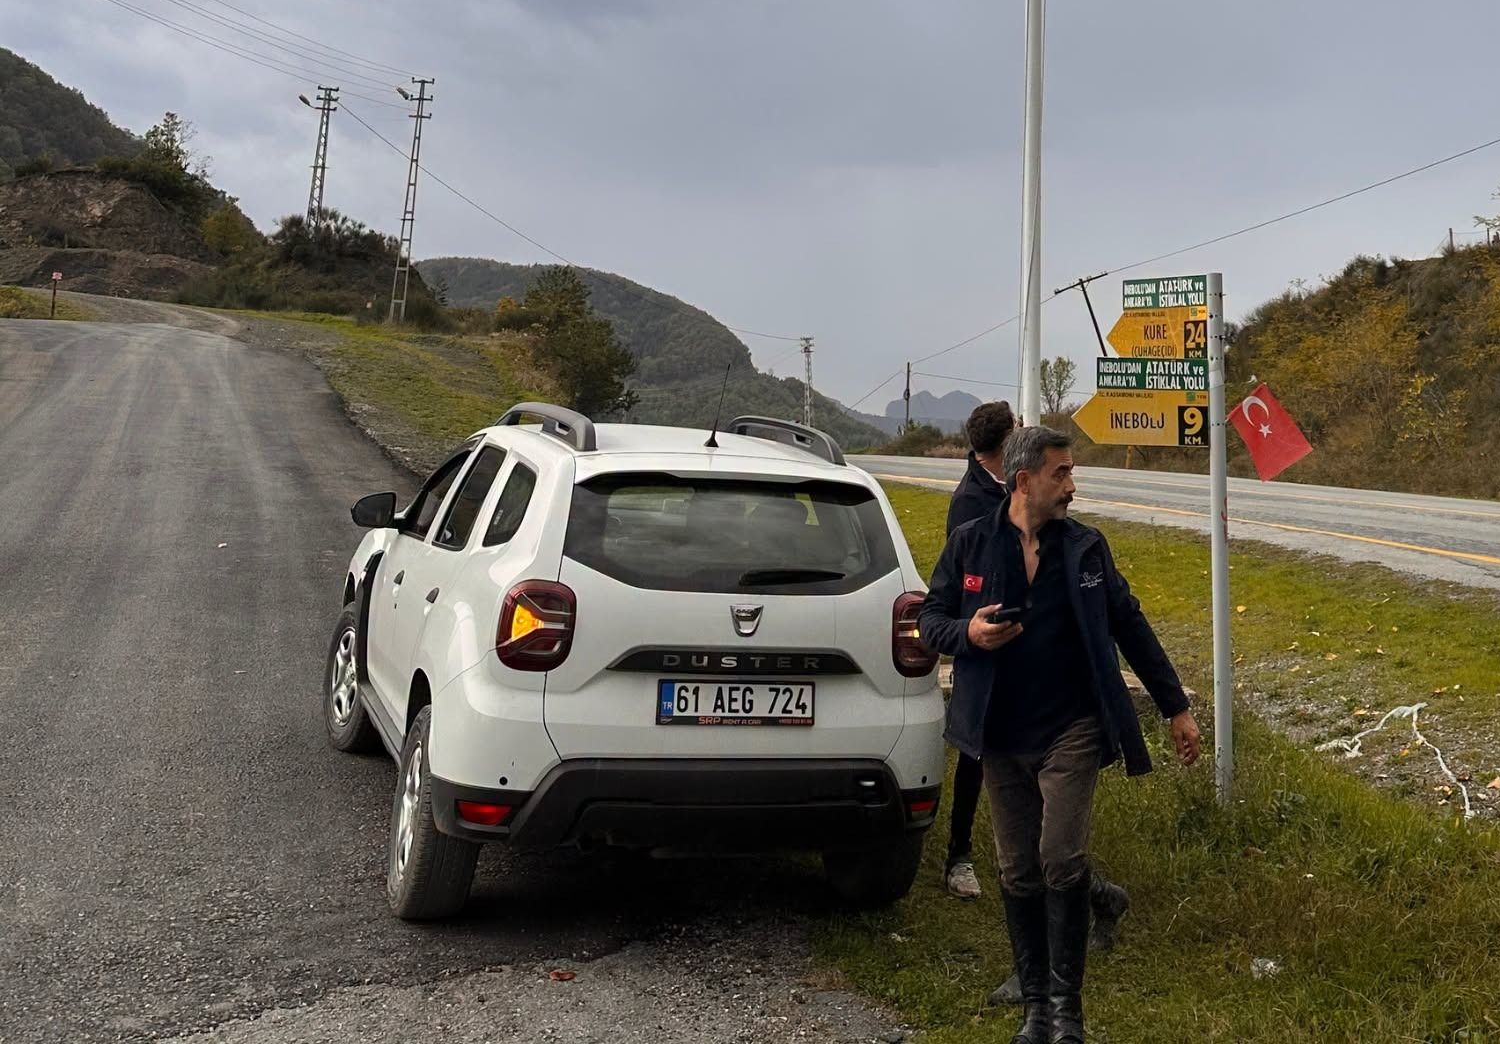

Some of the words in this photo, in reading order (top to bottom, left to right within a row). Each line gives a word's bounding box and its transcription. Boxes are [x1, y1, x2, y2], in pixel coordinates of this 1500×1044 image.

[1159, 278, 1193, 293] ATATÜRK
[1195, 282, 1204, 291] ve
[1187, 292, 1205, 305] YOLU
[1144, 321, 1167, 340] KÜRE
[1185, 322, 1206, 349] 24
[1099, 360, 1142, 374] İNEBOLU'DAN
[1146, 360, 1190, 375] ATATÜRK
[1192, 365, 1204, 376] ve
[1099, 375, 1137, 387] ANKARA'YA
[1146, 374, 1181, 389] İSTİKLAL
[1183, 376, 1205, 390] YOLU
[1183, 407, 1204, 435] 9
[662, 654, 820, 669] DUSTER
[663, 701, 673, 711] TR
[676, 685, 700, 713] 61
[712, 686, 754, 714] AEG
[768, 687, 808, 715] 724
[698, 716, 721, 725] SRP
